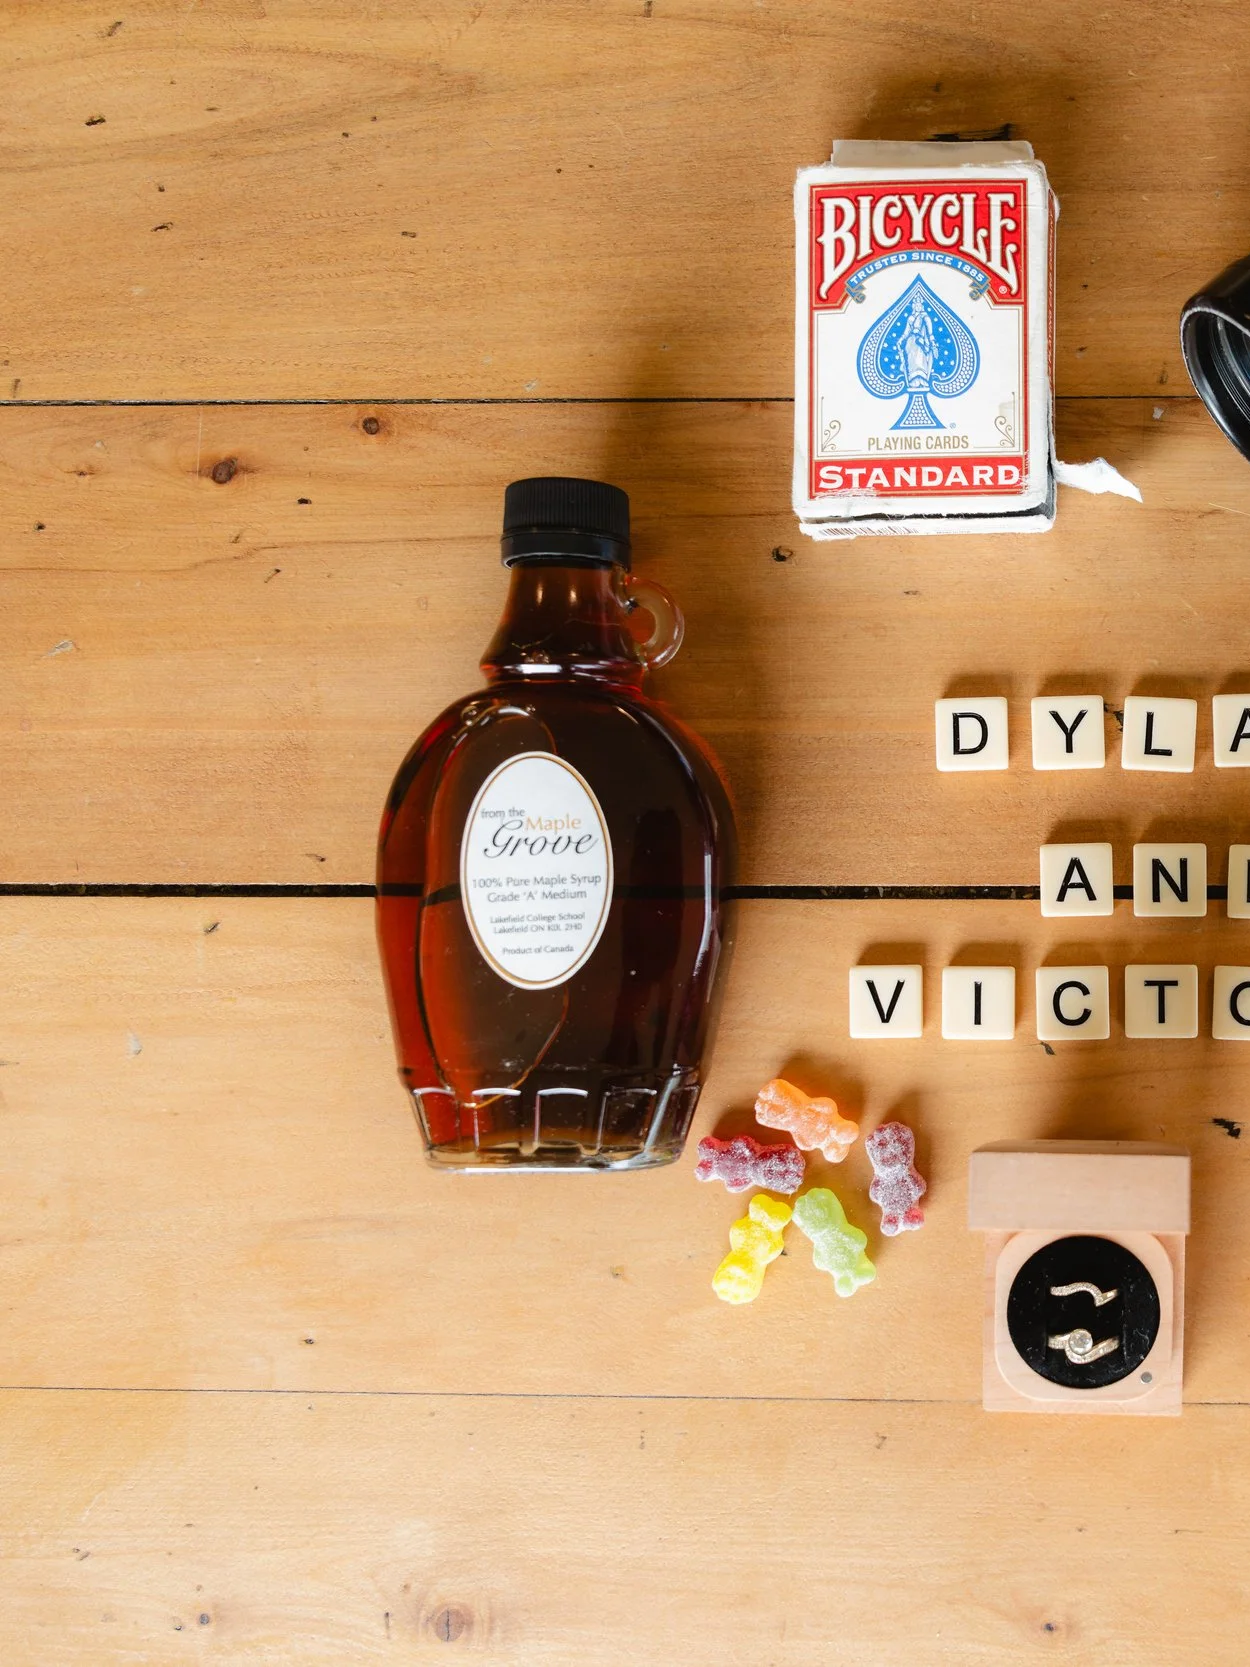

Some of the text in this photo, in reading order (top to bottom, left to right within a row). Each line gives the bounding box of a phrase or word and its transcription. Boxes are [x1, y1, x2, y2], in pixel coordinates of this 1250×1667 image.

[816, 192, 1019, 300] BICYCLE
[850, 252, 986, 285] TRUSTED SINCE 1885
[867, 435, 969, 451] PLAYING CARDS
[818, 464, 1020, 490] STANDARD
[481, 807, 526, 819] from the
[525, 813, 582, 834] Maple
[484, 819, 599, 859] Grove
[472, 873, 602, 889] 100% Pure Maple Syrup
[487, 891, 520, 903] Grade
[542, 889, 587, 900] Medium
[490, 912, 585, 923] Lakefield College School
[494, 925, 528, 934] Lakefield
[530, 924, 545, 933] ON
[502, 944, 574, 955] Product of Canada
